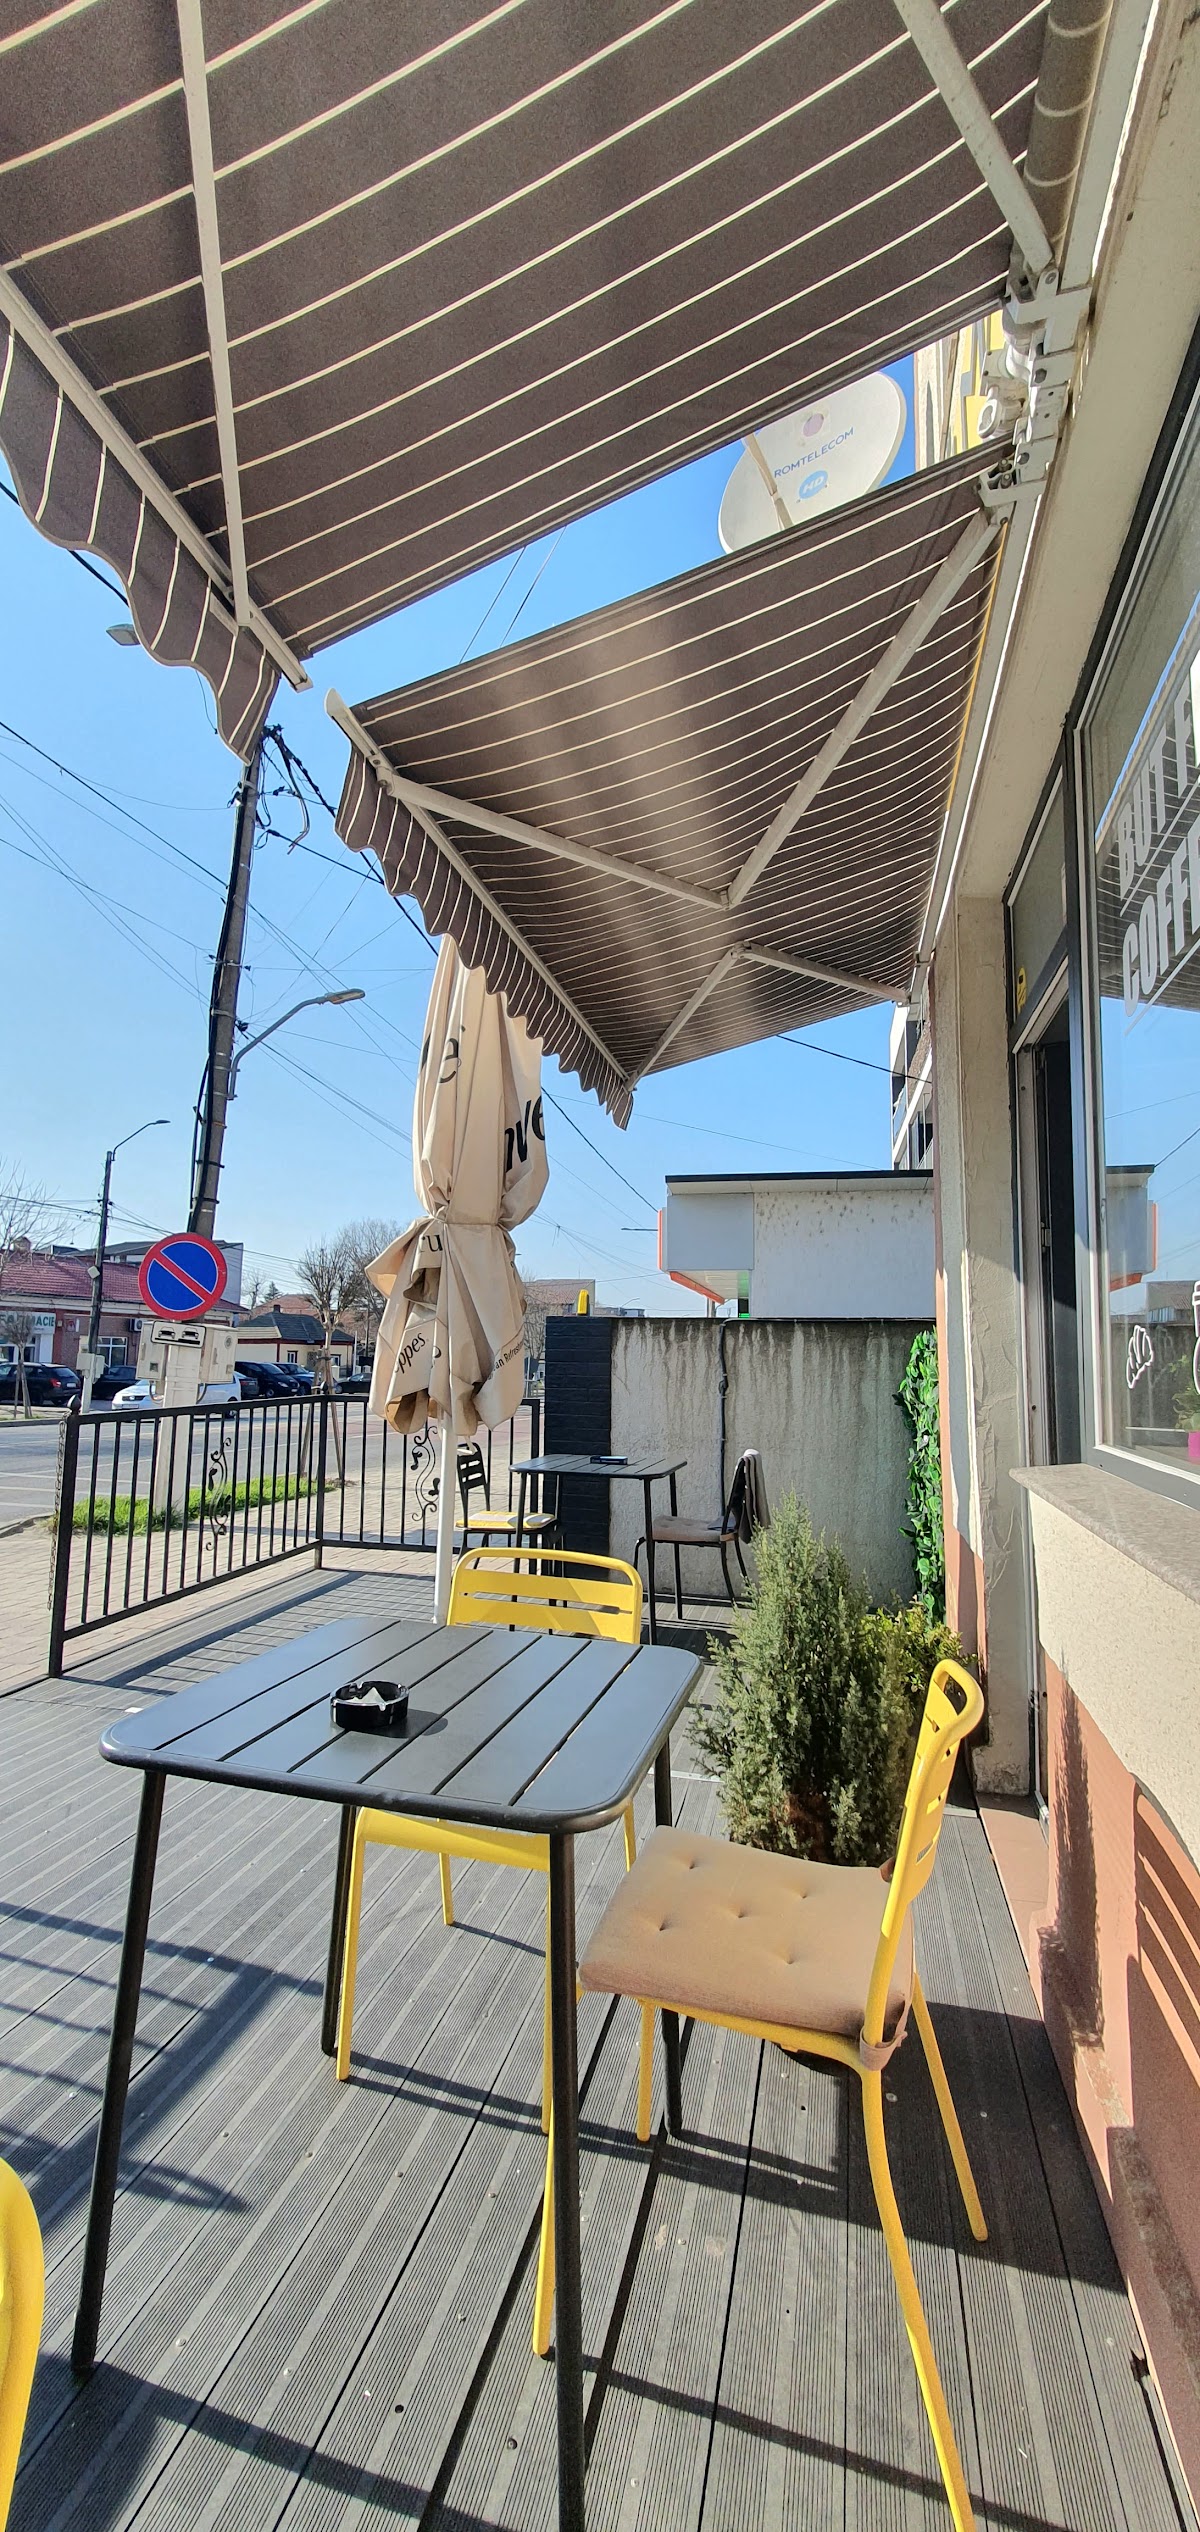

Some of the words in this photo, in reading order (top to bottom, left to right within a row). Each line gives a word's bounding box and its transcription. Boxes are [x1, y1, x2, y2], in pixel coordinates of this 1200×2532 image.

[774, 427, 854, 478] ROMTELECOM
[803, 476, 825, 493] HD
[1118, 722, 1167, 900] BUT
